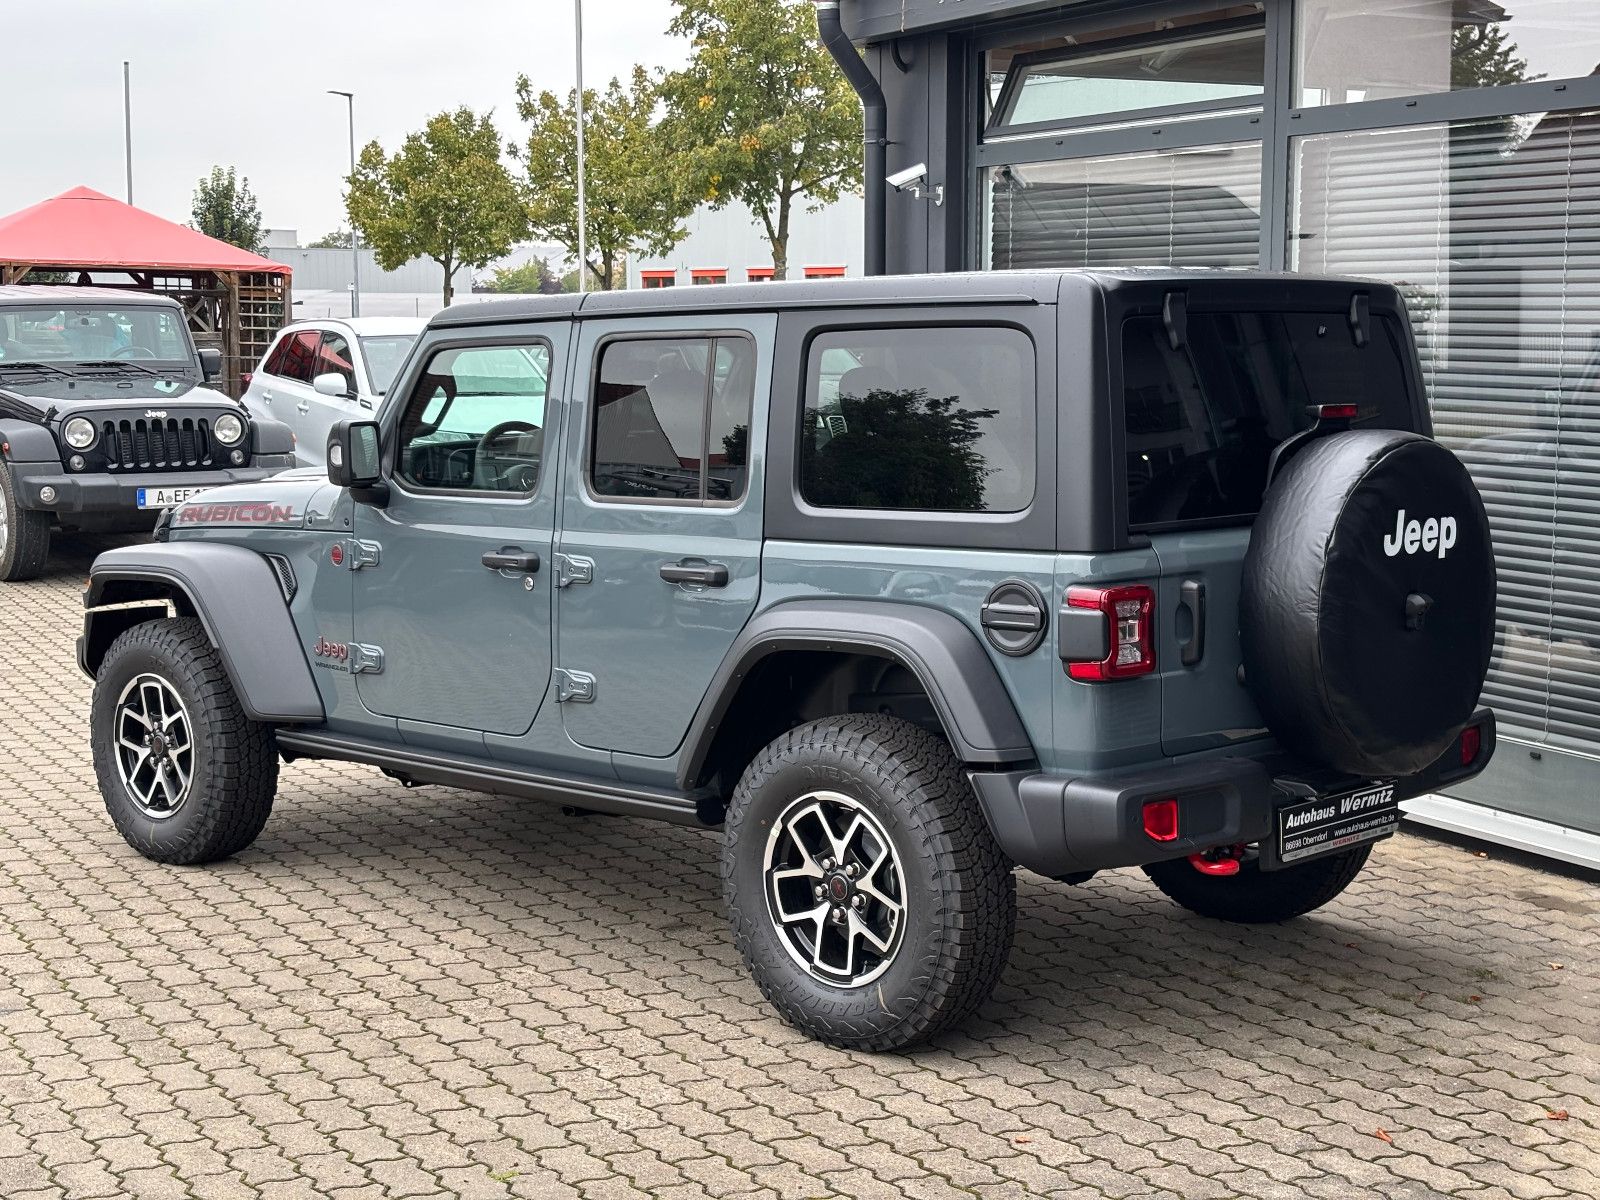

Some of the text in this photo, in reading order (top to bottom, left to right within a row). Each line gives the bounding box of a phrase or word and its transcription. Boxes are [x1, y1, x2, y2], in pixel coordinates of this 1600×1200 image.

[145, 410, 167, 418] Jeep
[156, 490, 165, 503] A
[179, 503, 293, 522] RUBICON
[1383, 509, 1457, 559] Jeep
[313, 636, 348, 663] Jeep
[1286, 790, 1394, 829] Autohaus Wernitz
[1334, 814, 1395, 837] www.autohaus-wernitz.de
